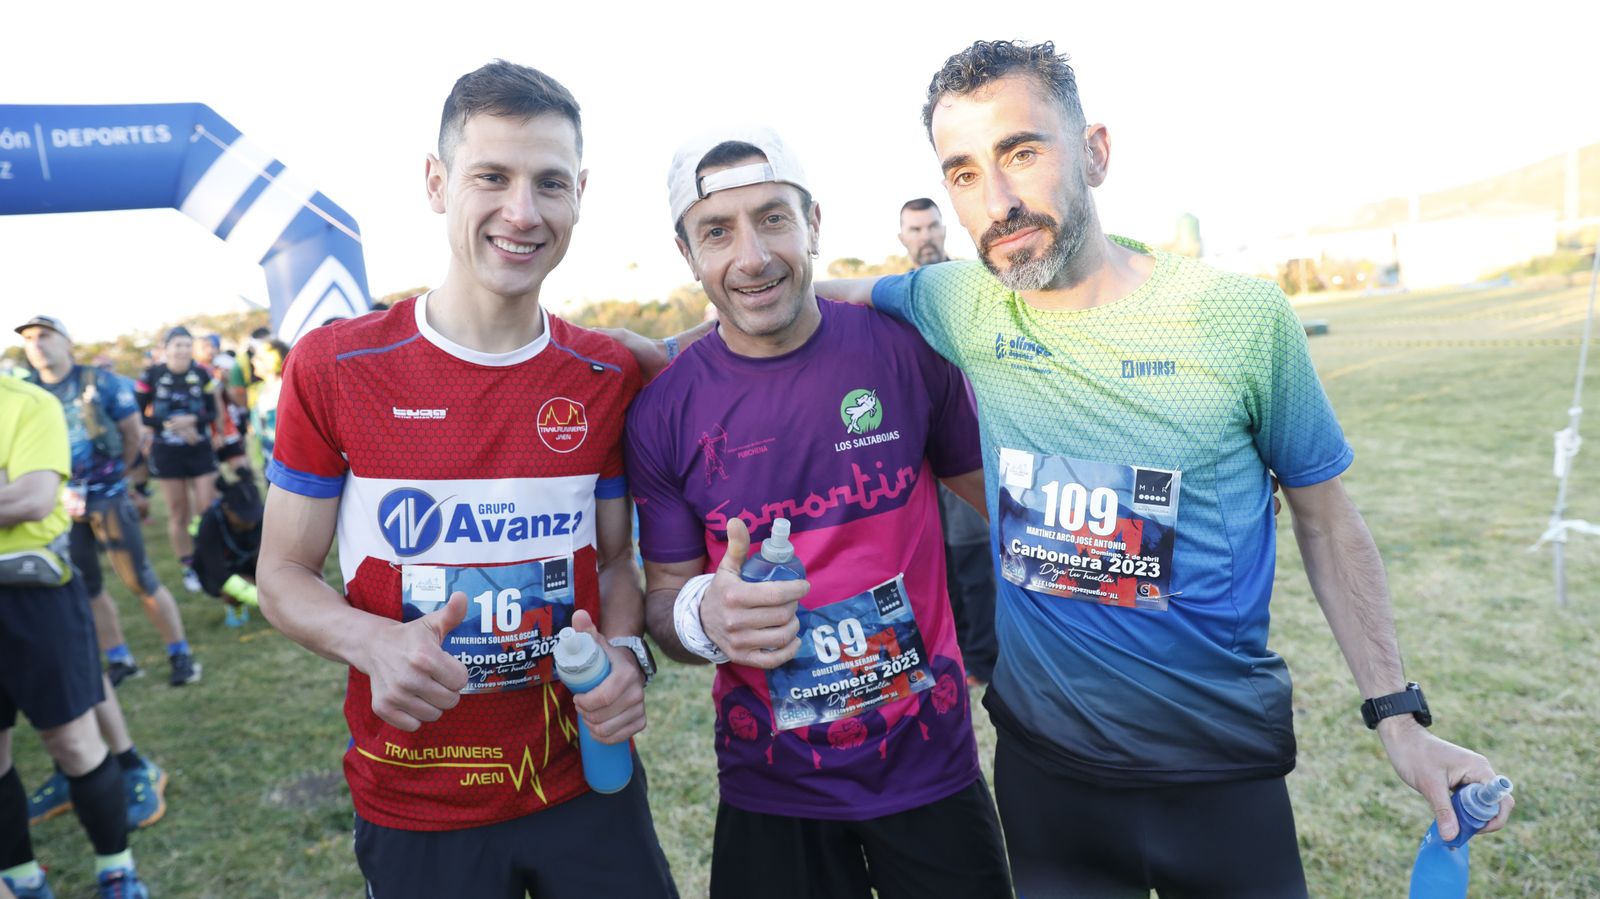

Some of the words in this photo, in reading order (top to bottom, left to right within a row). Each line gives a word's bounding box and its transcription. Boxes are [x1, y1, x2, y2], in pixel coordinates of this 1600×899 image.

[51, 124, 172, 148] DEPORTES
[835, 440, 852, 452] LOS
[853, 430, 900, 448] SALTABOJAS
[478, 502, 515, 514] GRUPO
[1041, 481, 1118, 536] 109
[1094, 538, 1126, 550] ANTONIO
[1012, 539, 1102, 570] Carbonera
[1108, 558, 1160, 578] 2023
[474, 588, 522, 634] 16
[451, 636, 487, 645] AYMERICH
[531, 640, 558, 658] 202
[812, 617, 868, 664] 69
[790, 671, 878, 700] Carbonera
[881, 652, 920, 678] 2023
[384, 742, 504, 760] TRAILRUNNERS
[460, 772, 504, 786] JAEN
